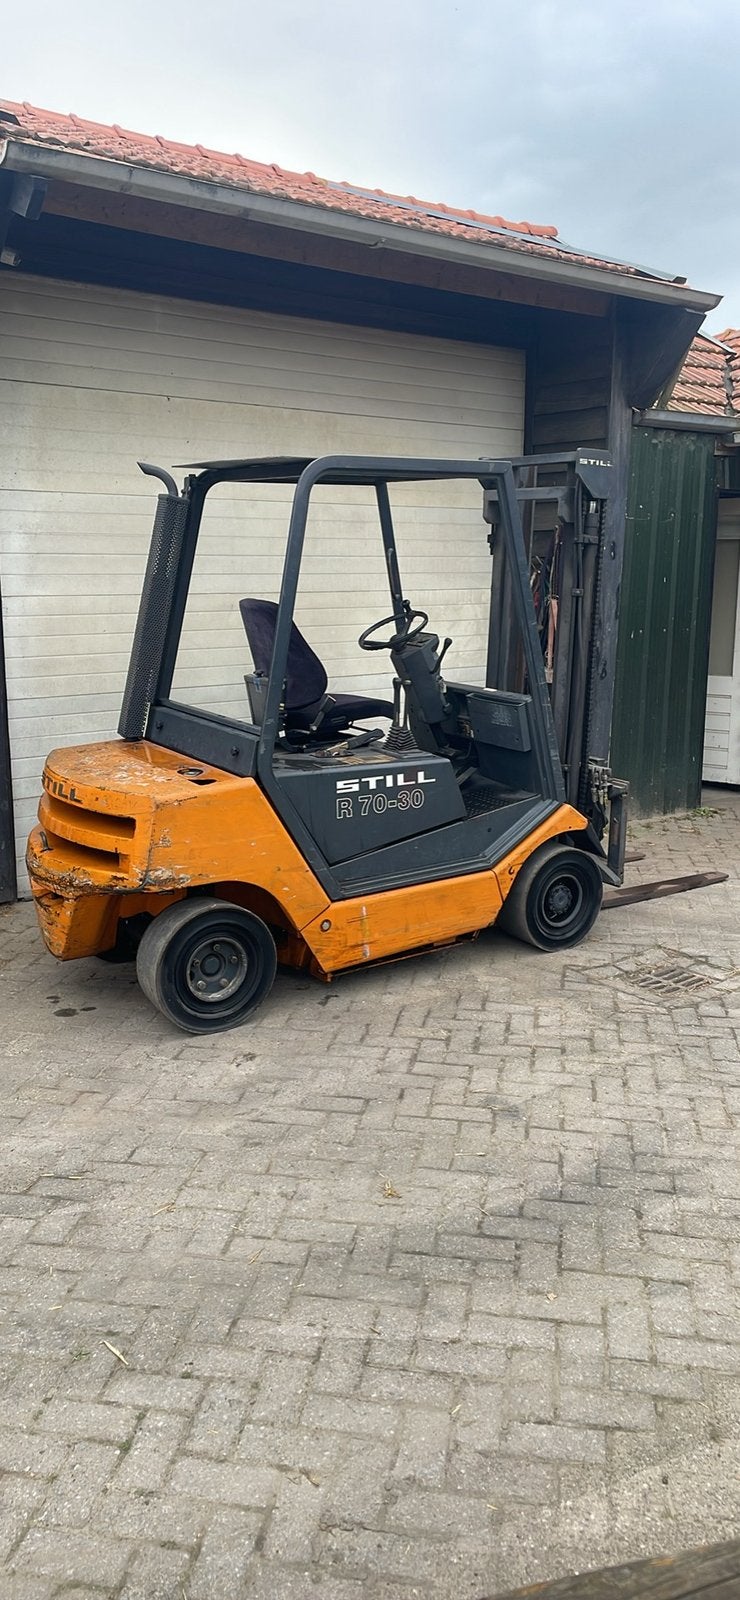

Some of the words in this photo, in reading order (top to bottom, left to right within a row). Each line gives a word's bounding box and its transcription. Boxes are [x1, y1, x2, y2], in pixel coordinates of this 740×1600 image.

[336, 771, 436, 794] STILL
[336, 797, 353, 819] R
[358, 788, 425, 816] 70-30
